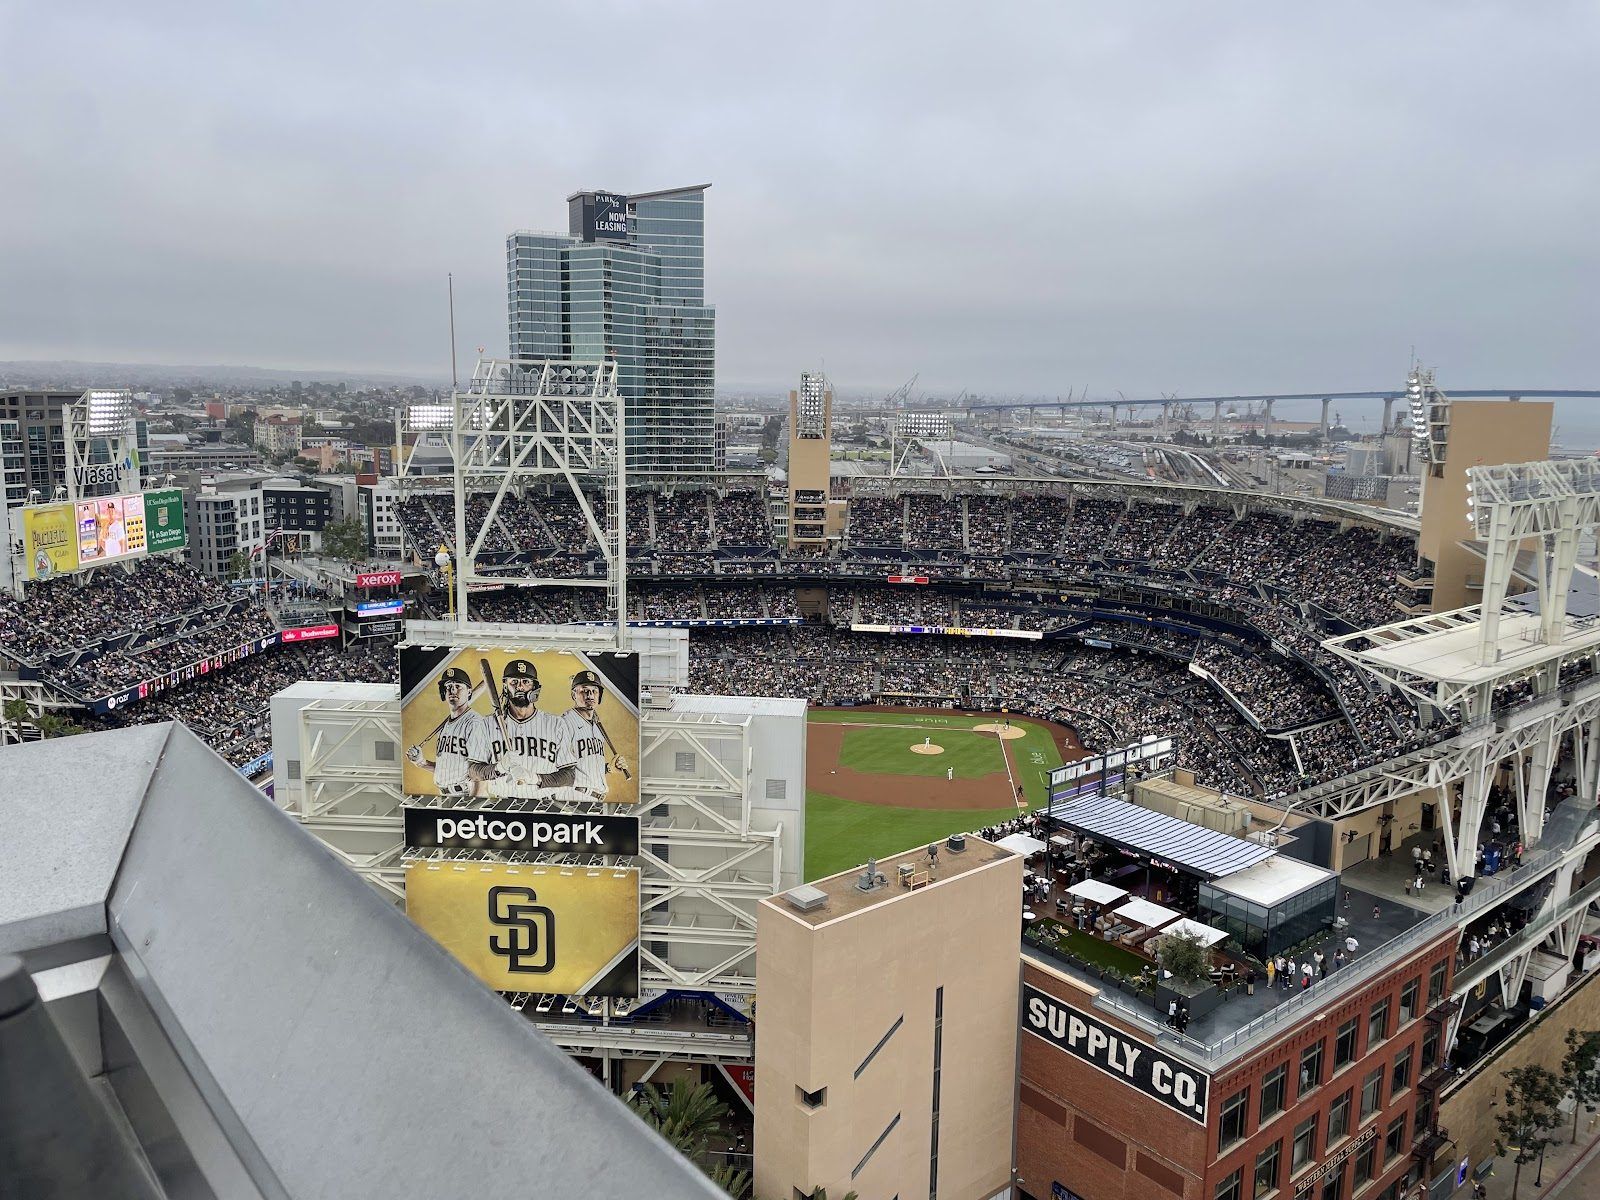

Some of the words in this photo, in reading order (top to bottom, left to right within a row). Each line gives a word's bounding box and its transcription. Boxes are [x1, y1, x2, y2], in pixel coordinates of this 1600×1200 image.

[609, 212, 626, 222] NOW
[595, 221, 627, 232] LEASING
[73, 463, 122, 486] Viasat
[160, 530, 168, 538] San
[168, 528, 182, 536] Diego
[361, 573, 397, 586] xerox
[301, 629, 336, 638] Budweiser
[116, 693, 130, 705] razr
[437, 735, 469, 757] DRES
[436, 814, 527, 844] petco
[532, 821, 604, 848] park
[1028, 997, 1141, 1078] SUPPLY
[1151, 1060, 1203, 1115] CO.
[1297, 1167, 1325, 1192] WESTERN
[1325, 1152, 1345, 1171] METAL
[1344, 1136, 1365, 1155] SUPPLY
[1365, 1129, 1374, 1139] CO.
